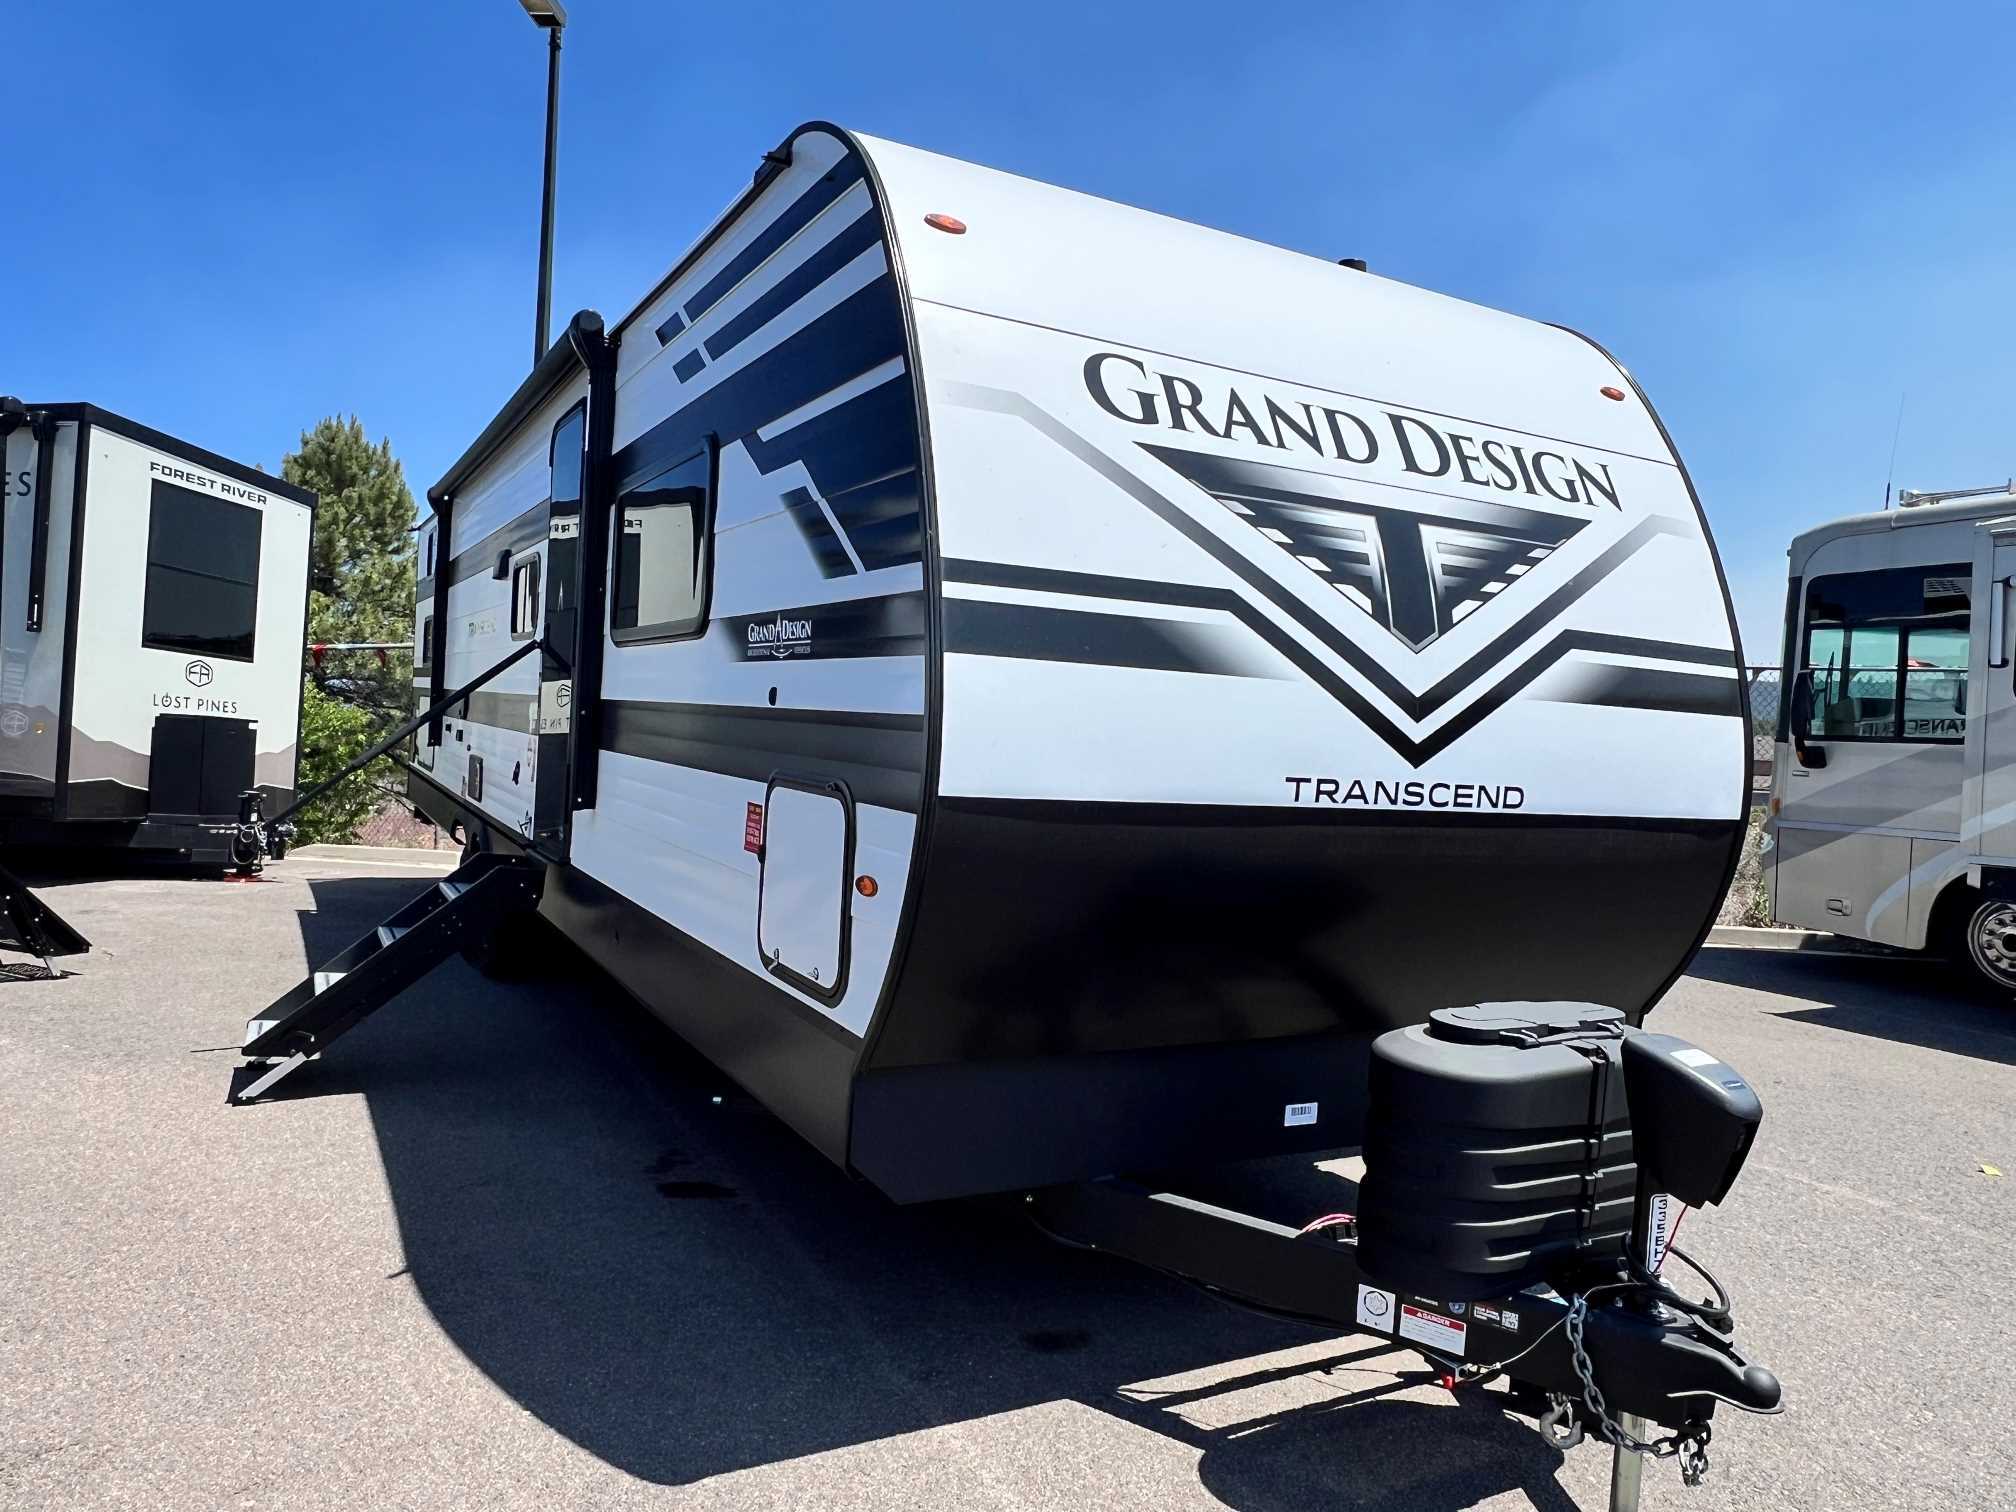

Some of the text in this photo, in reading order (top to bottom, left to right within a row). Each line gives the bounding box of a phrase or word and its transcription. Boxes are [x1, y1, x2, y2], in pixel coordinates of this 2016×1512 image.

[1083, 352, 1623, 513] GRAND DESIGN
[150, 461, 267, 505] FOREST RIVER
[748, 620, 812, 642] GRAND DESIGN
[153, 692, 237, 714] LOST PINES
[1286, 776, 1525, 809] TRANSCEND
